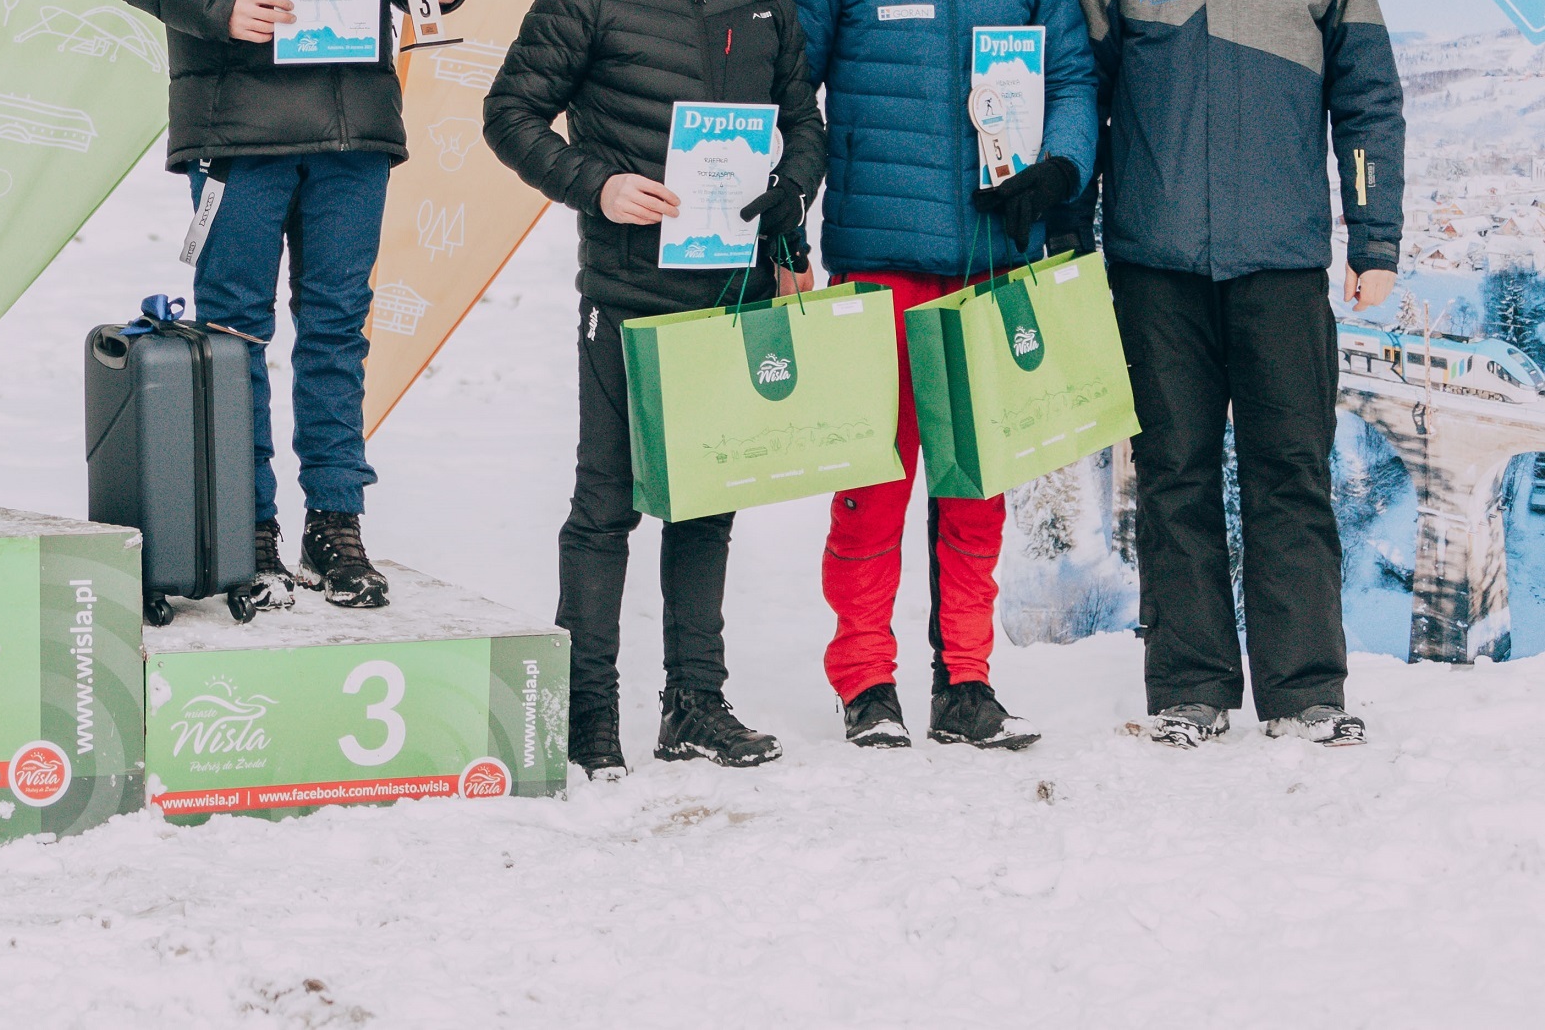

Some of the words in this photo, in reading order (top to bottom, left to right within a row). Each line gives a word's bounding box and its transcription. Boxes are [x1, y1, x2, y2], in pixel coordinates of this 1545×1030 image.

[980, 35, 1035, 56] Dyplom
[684, 110, 764, 133] Dyplom
[993, 138, 1003, 161] 5
[70, 579, 93, 755] www.wisla.pl
[338, 660, 407, 767] 3
[522, 660, 538, 769] www.wisla.pl
[162, 792, 239, 809] www.wisla.pl
[259, 780, 450, 803] www.facebook.com/miasto.wisla
